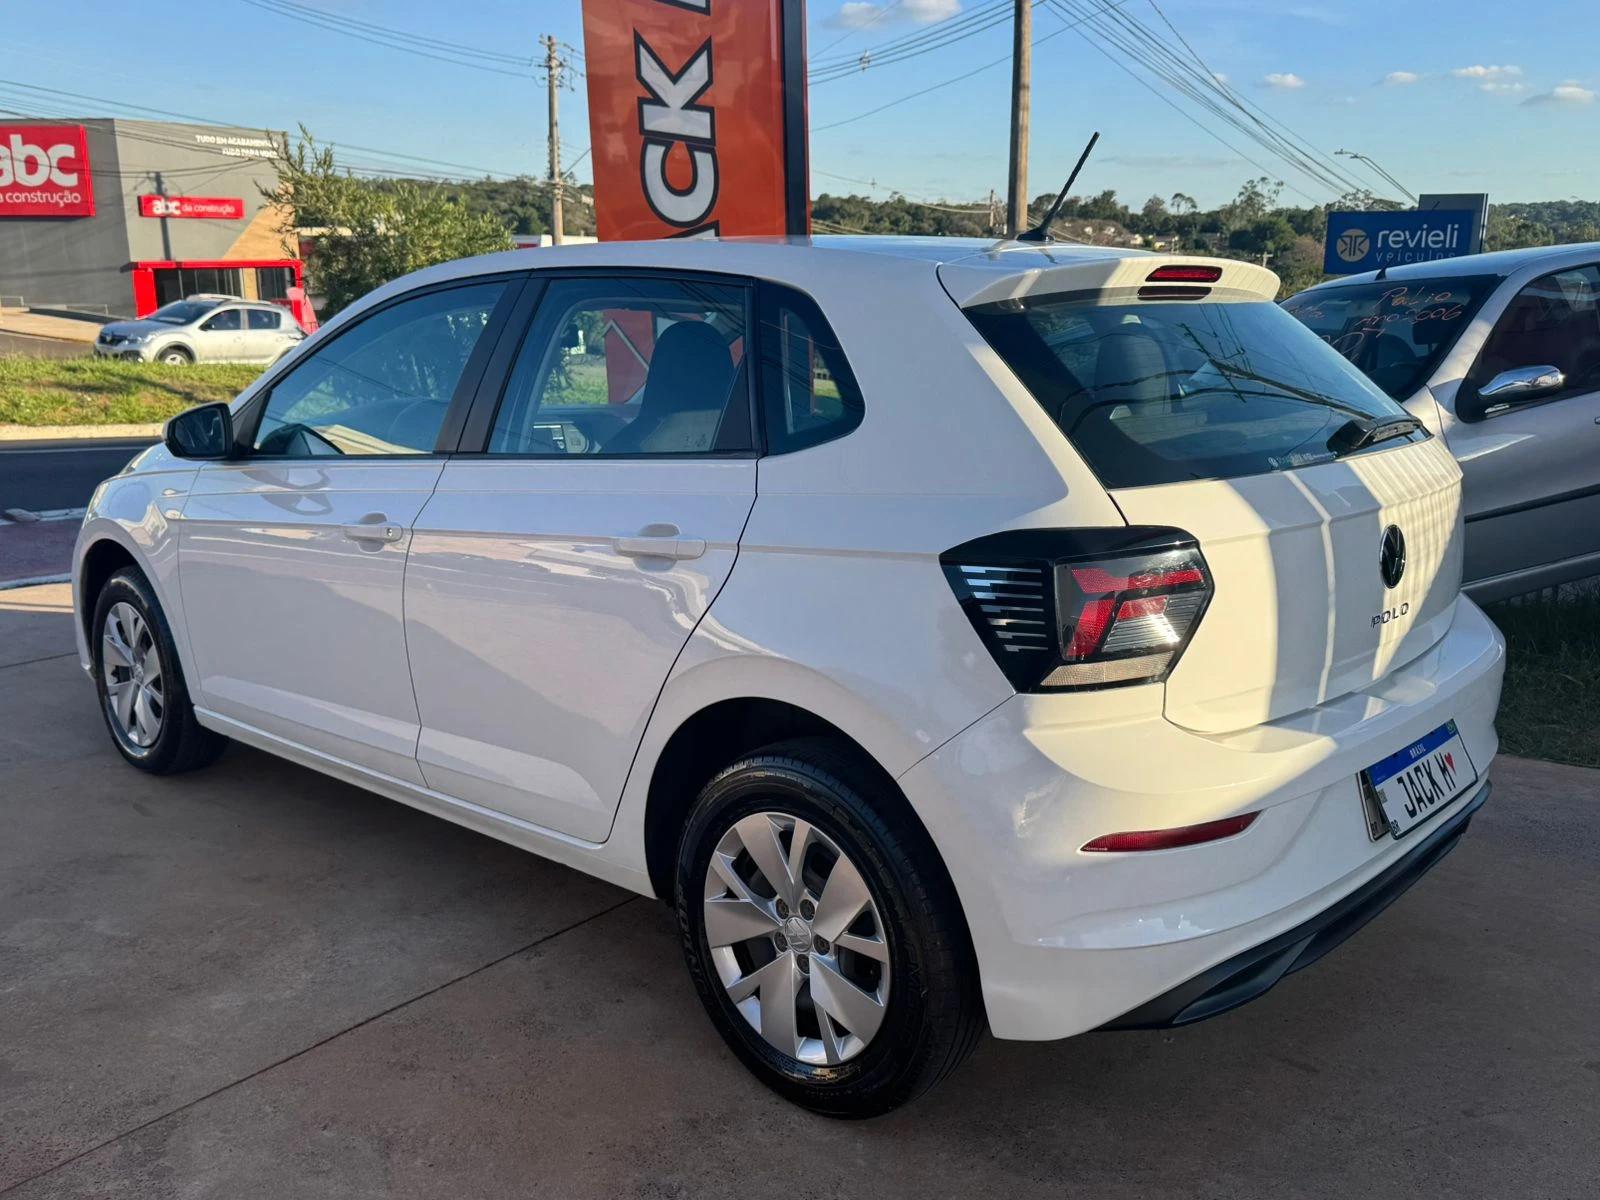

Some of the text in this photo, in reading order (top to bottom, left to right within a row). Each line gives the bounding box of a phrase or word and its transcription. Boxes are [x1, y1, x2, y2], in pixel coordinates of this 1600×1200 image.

[5, 190, 81, 207] construção
[152, 198, 181, 215] abc
[1377, 223, 1459, 249] revieli
[1371, 602, 1409, 628] POLO
[1396, 759, 1445, 819] JACK
